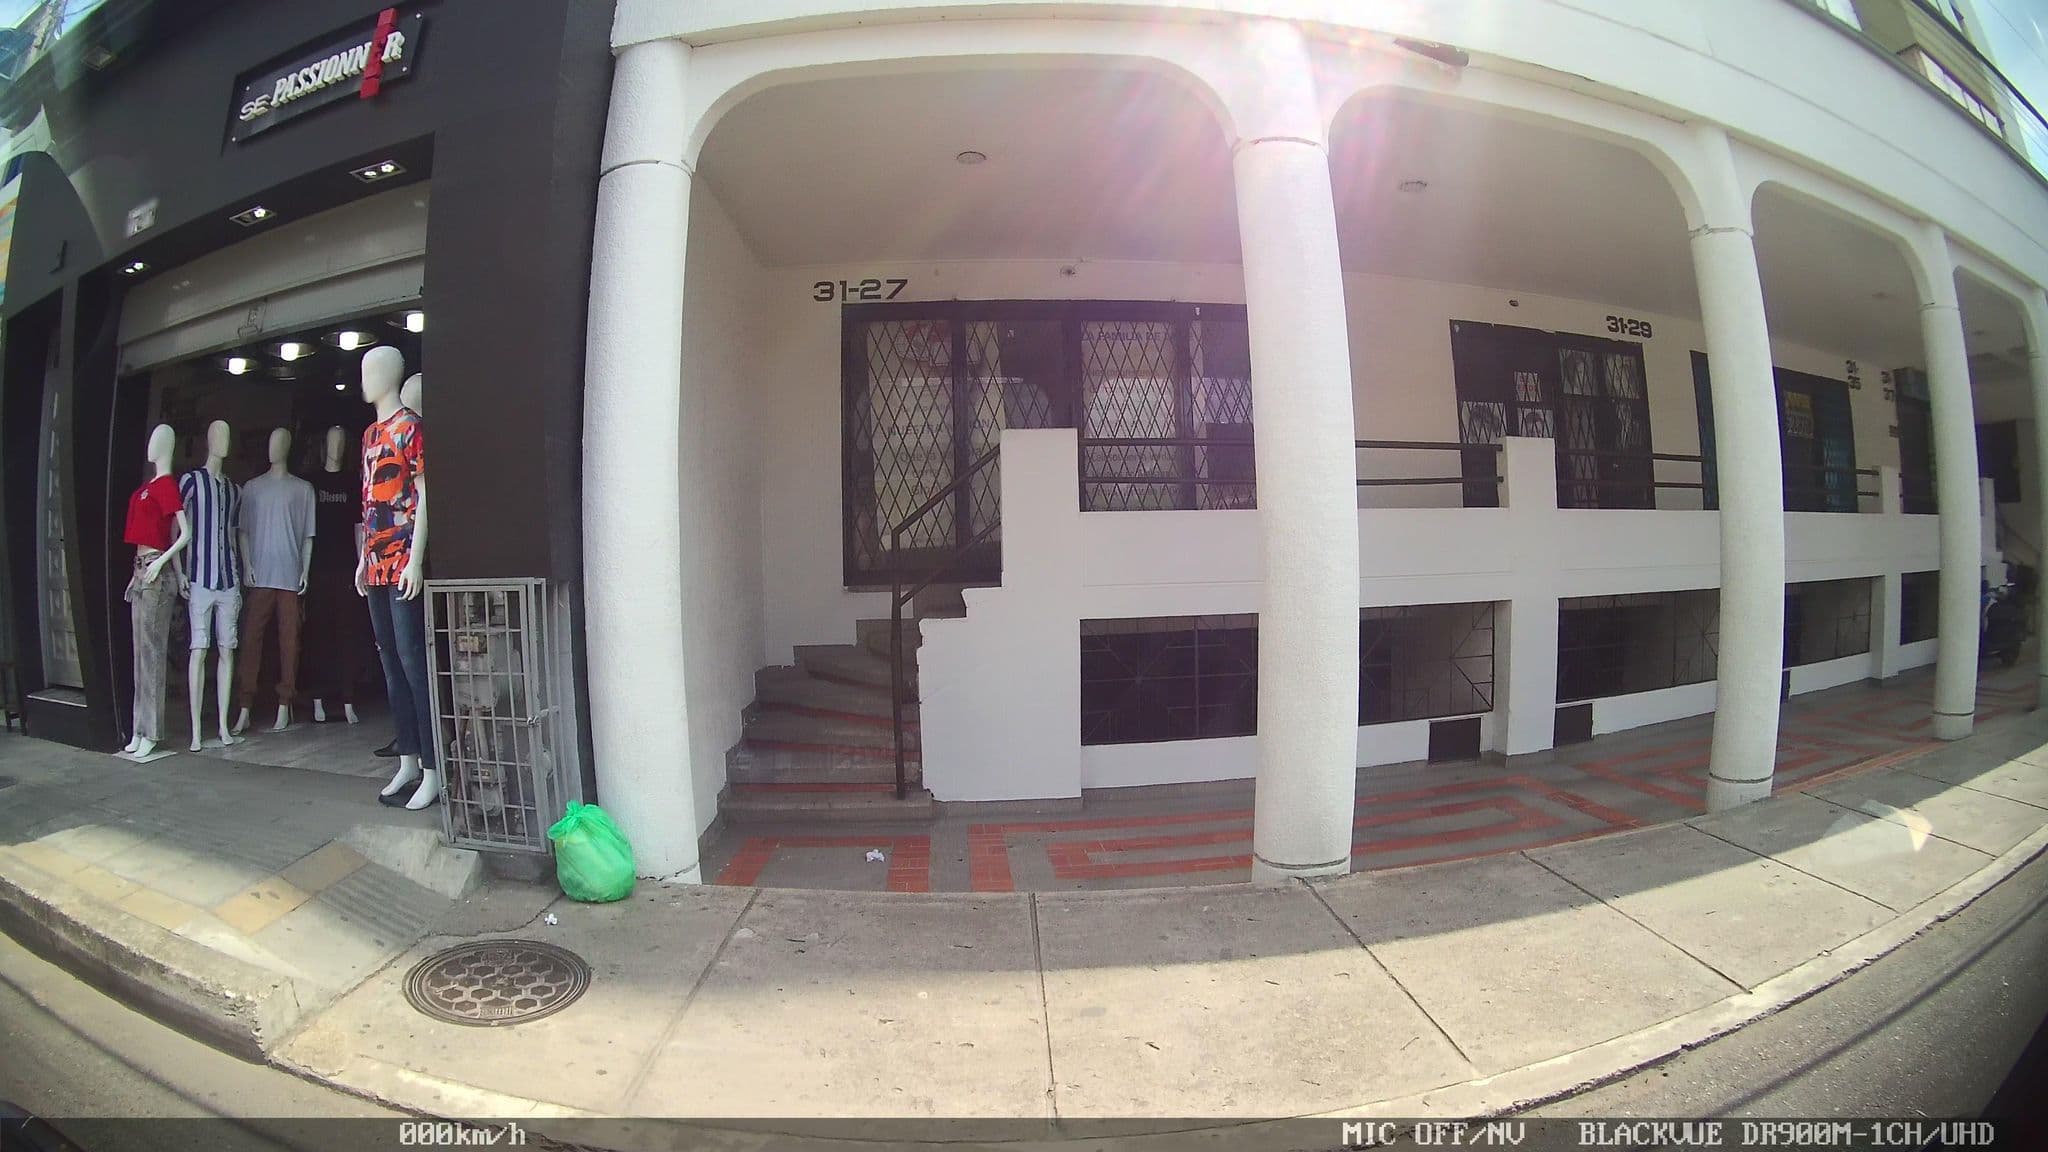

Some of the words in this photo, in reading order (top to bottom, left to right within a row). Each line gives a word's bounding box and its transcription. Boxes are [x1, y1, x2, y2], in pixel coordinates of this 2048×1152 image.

[239, 94, 273, 122] SE
[813, 278, 909, 302] 31-27
[1606, 314, 1653, 339] 31-29
